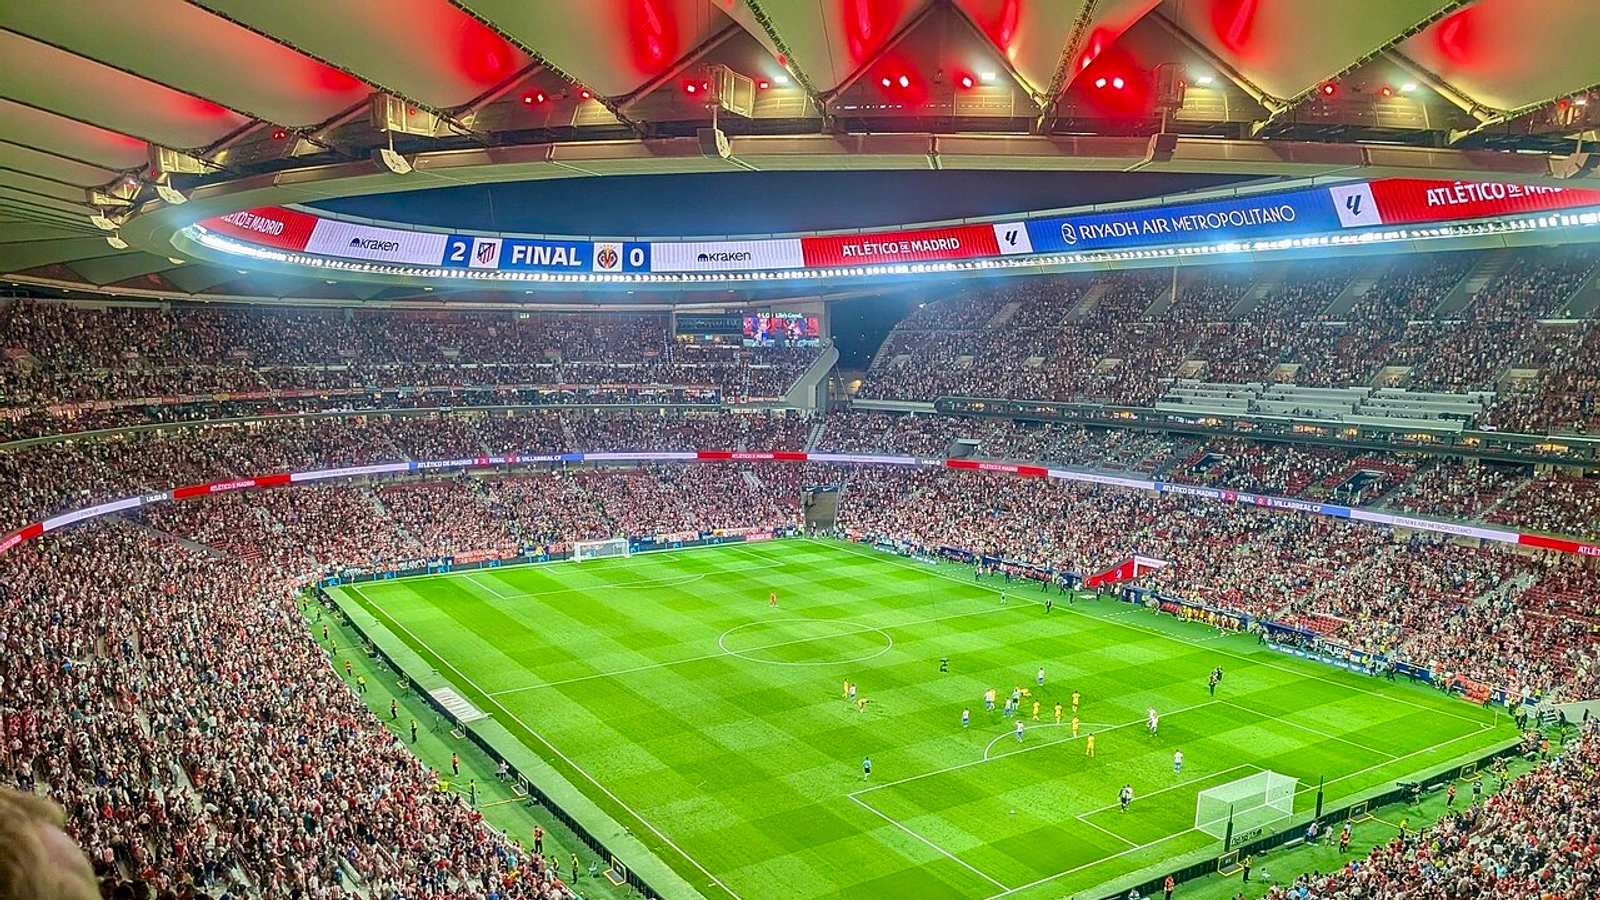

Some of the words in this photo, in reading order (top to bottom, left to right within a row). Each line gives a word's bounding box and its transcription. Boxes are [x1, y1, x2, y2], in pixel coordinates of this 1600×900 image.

[1426, 181, 1506, 206] ATLÉTICO
[249, 215, 285, 236] MADRID
[1079, 220, 1139, 240] RIYADH
[1142, 218, 1170, 235] AIR
[1171, 204, 1296, 232] METROPOLITANO
[360, 238, 400, 252] kraken
[450, 241, 467, 262] 2
[842, 240, 899, 257] ATLÉTICO
[911, 237, 960, 252] MADRID
[511, 245, 583, 267] FINAL
[629, 247, 645, 267] 0
[708, 251, 752, 262] kraken
